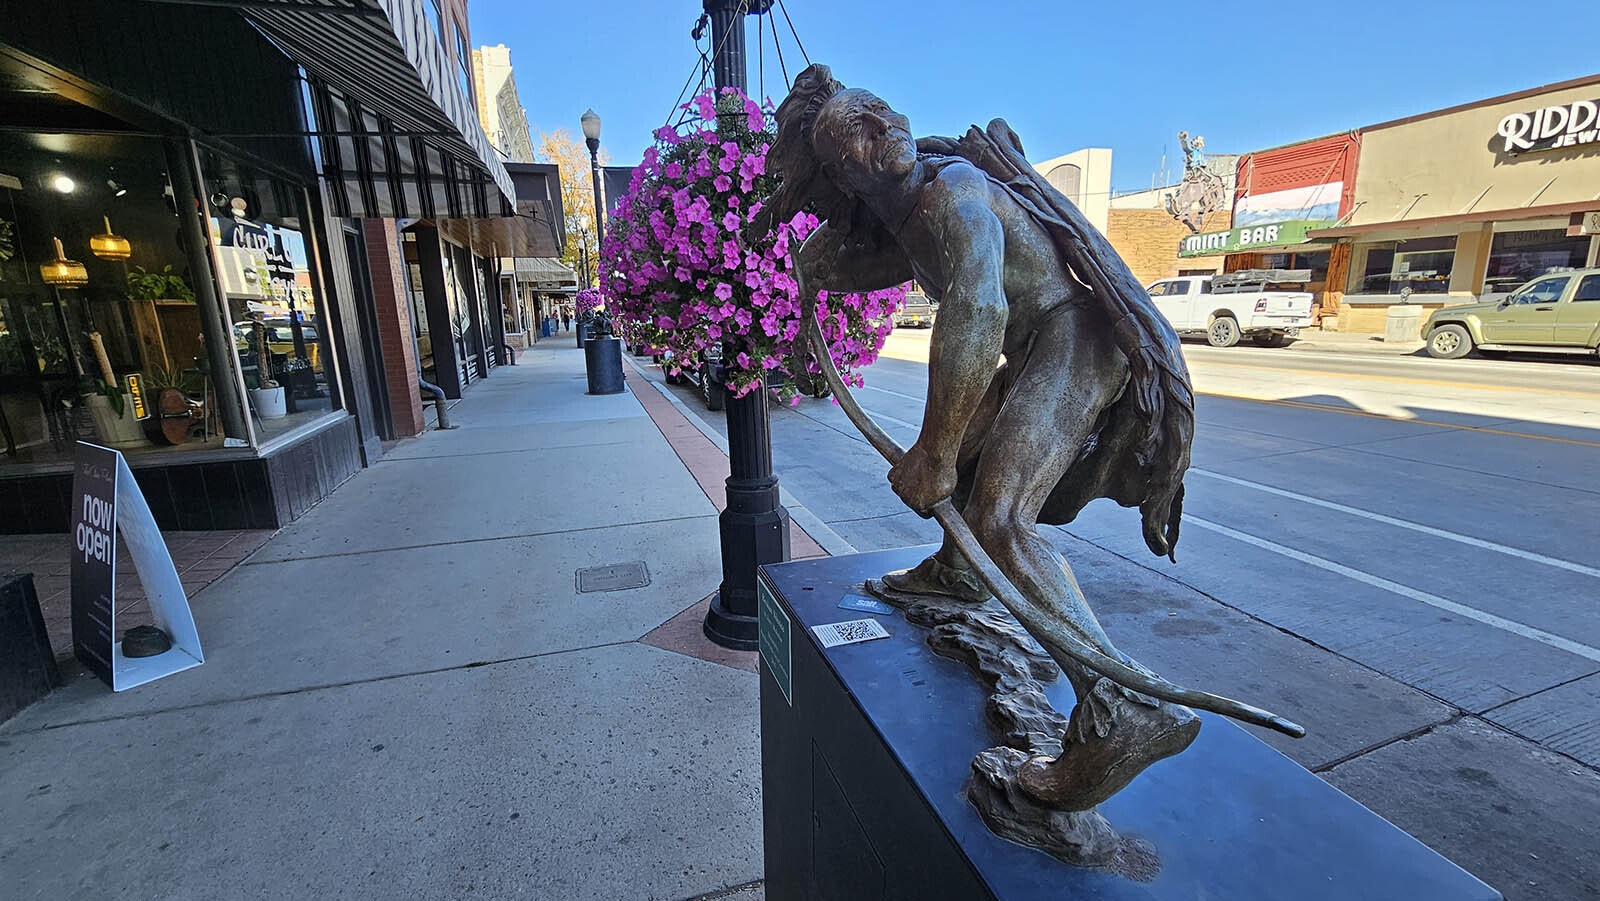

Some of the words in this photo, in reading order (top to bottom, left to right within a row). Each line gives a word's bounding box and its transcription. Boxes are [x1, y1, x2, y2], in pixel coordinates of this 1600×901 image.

[1497, 100, 1600, 152] RIDD
[1186, 231, 1231, 251] MINT
[1239, 225, 1279, 245] BAR
[83, 493, 112, 531] now
[76, 522, 111, 565] open
